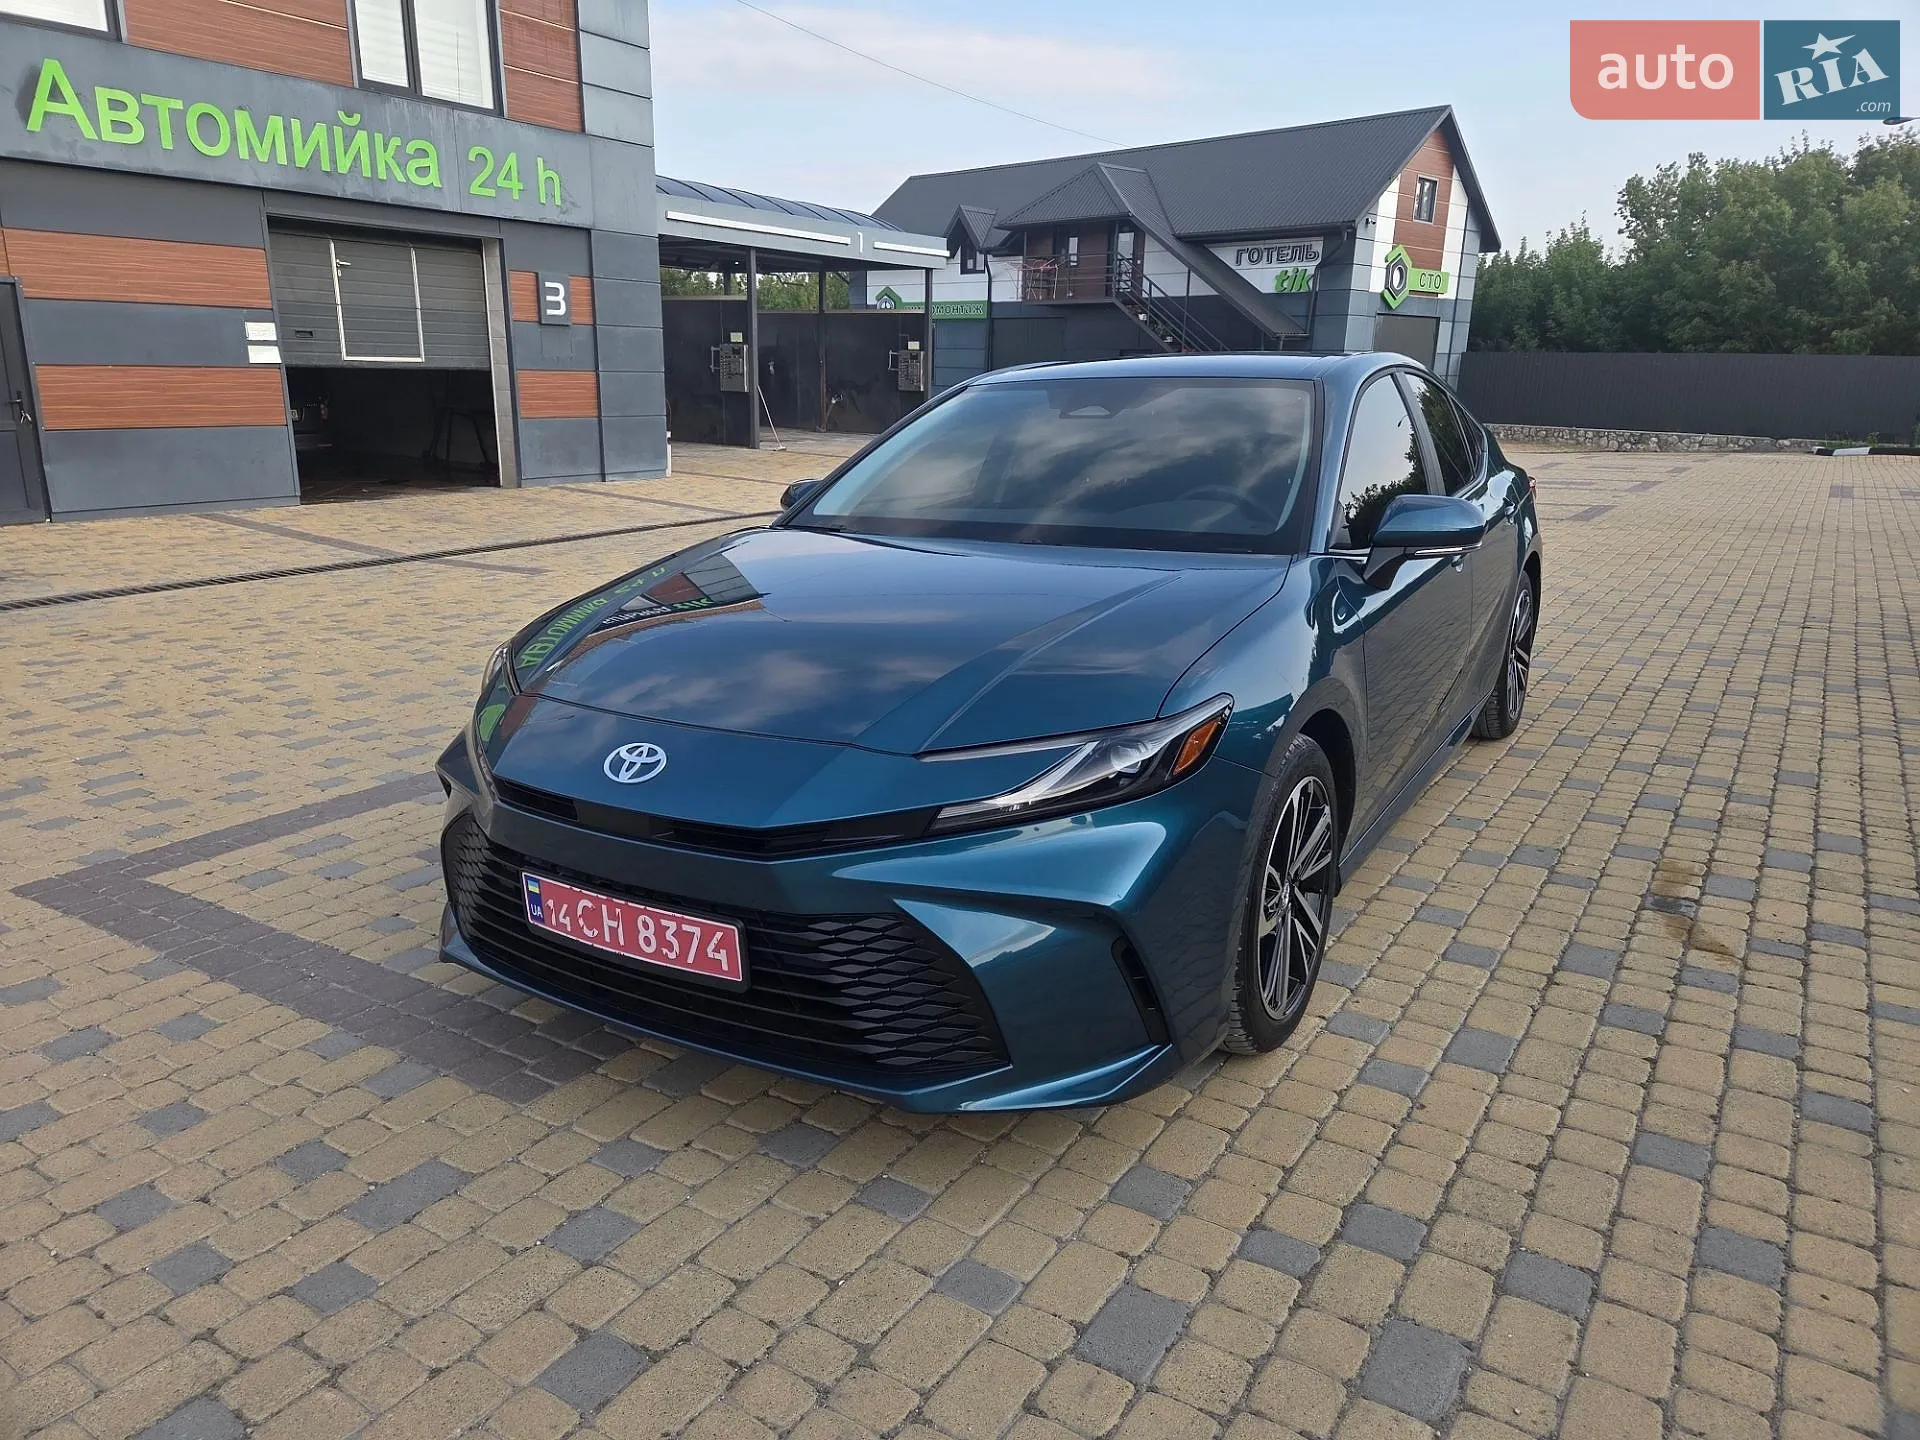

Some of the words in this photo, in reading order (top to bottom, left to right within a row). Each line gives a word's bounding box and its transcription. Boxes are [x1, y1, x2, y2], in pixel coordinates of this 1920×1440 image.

[469, 146, 523, 200] 24
[537, 156, 562, 206] h
[1235, 243, 1320, 266] ГОТЕЛЬ
[1420, 272, 1442, 290] СТО
[531, 903, 544, 920] UA
[636, 914, 730, 972] 8374
